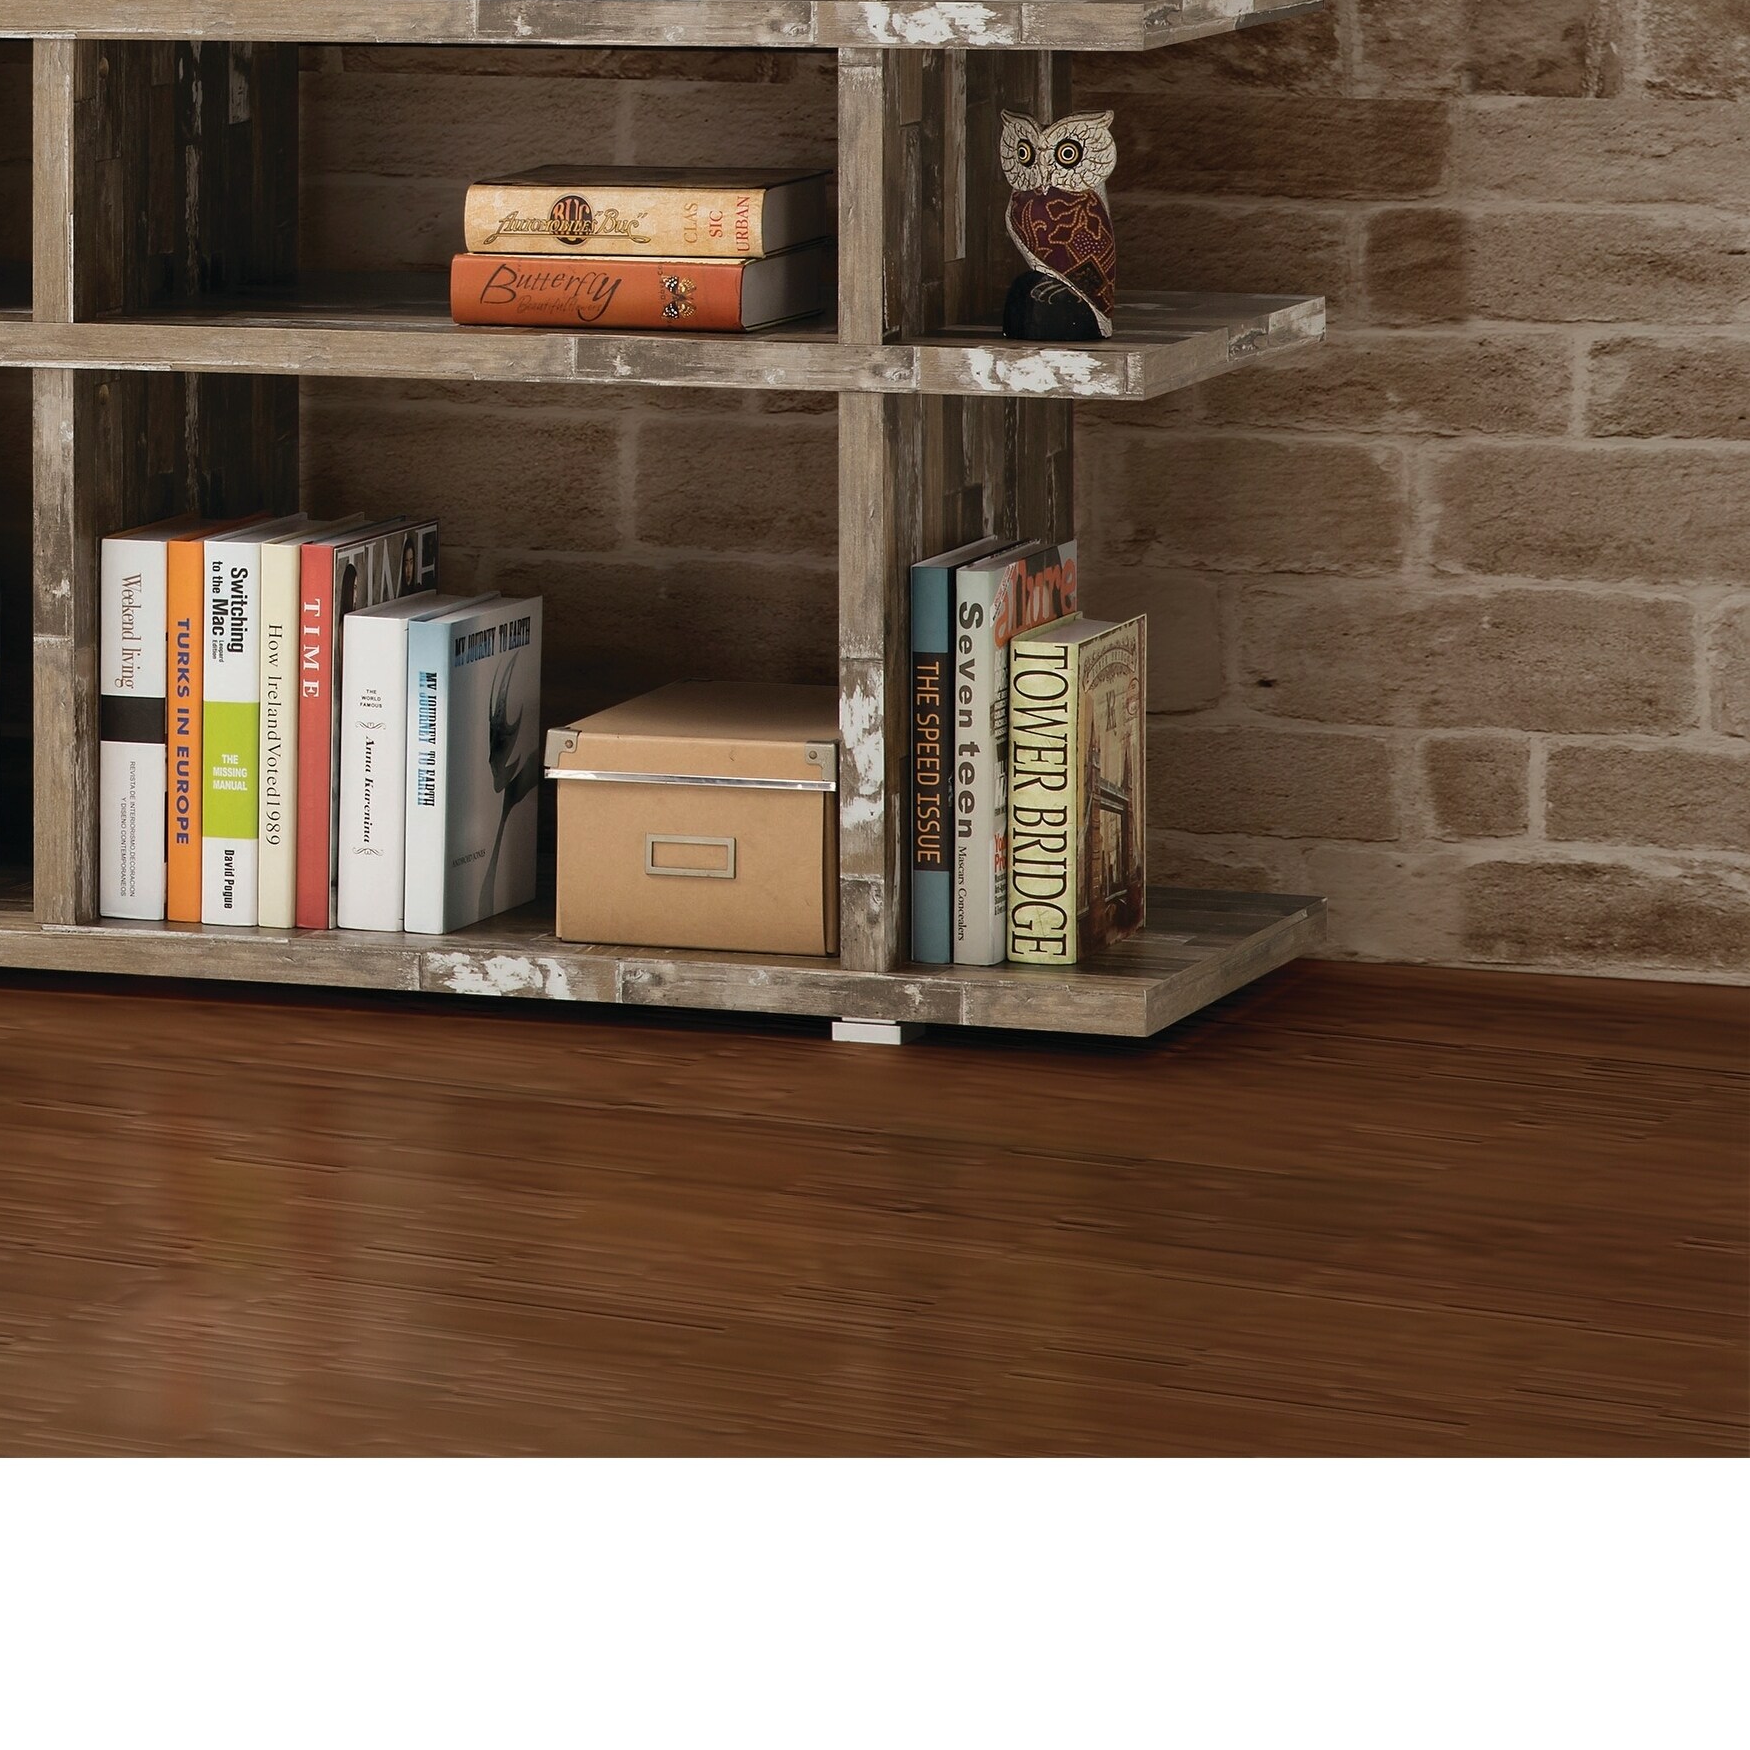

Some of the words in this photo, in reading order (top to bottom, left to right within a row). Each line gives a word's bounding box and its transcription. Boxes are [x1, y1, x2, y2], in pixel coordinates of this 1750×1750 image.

[683, 202, 698, 244] CLAS
[709, 210, 723, 238] SIC
[735, 196, 750, 252] URBAN
[480, 263, 622, 322] Butterfly
[212, 561, 223, 572] to
[212, 576, 223, 593] the
[121, 573, 142, 641] Weekend
[212, 599, 229, 636] Mac
[226, 567, 249, 653] Switching
[114, 648, 142, 689] living
[176, 618, 191, 698] TURKS
[268, 624, 283, 667] How
[303, 598, 321, 698] TIME
[958, 602, 984, 728] Seven
[917, 661, 940, 706] THE
[177, 708, 190, 735] IN
[1012, 645, 1069, 792] TOWER
[212, 766, 248, 778] MISSING
[222, 754, 239, 764] THE
[365, 736, 375, 772] Anna
[917, 713, 940, 786] SPEED
[176, 746, 190, 844] EUROPE
[212, 780, 248, 791] MANUAL
[363, 777, 374, 843] Karenina
[958, 741, 980, 838] teen
[917, 793, 940, 864] ISSUE
[224, 850, 235, 877] David
[1011, 804, 1068, 957] BRIDGE
[222, 879, 235, 909] Pogue
[958, 888, 967, 941] Concealers
